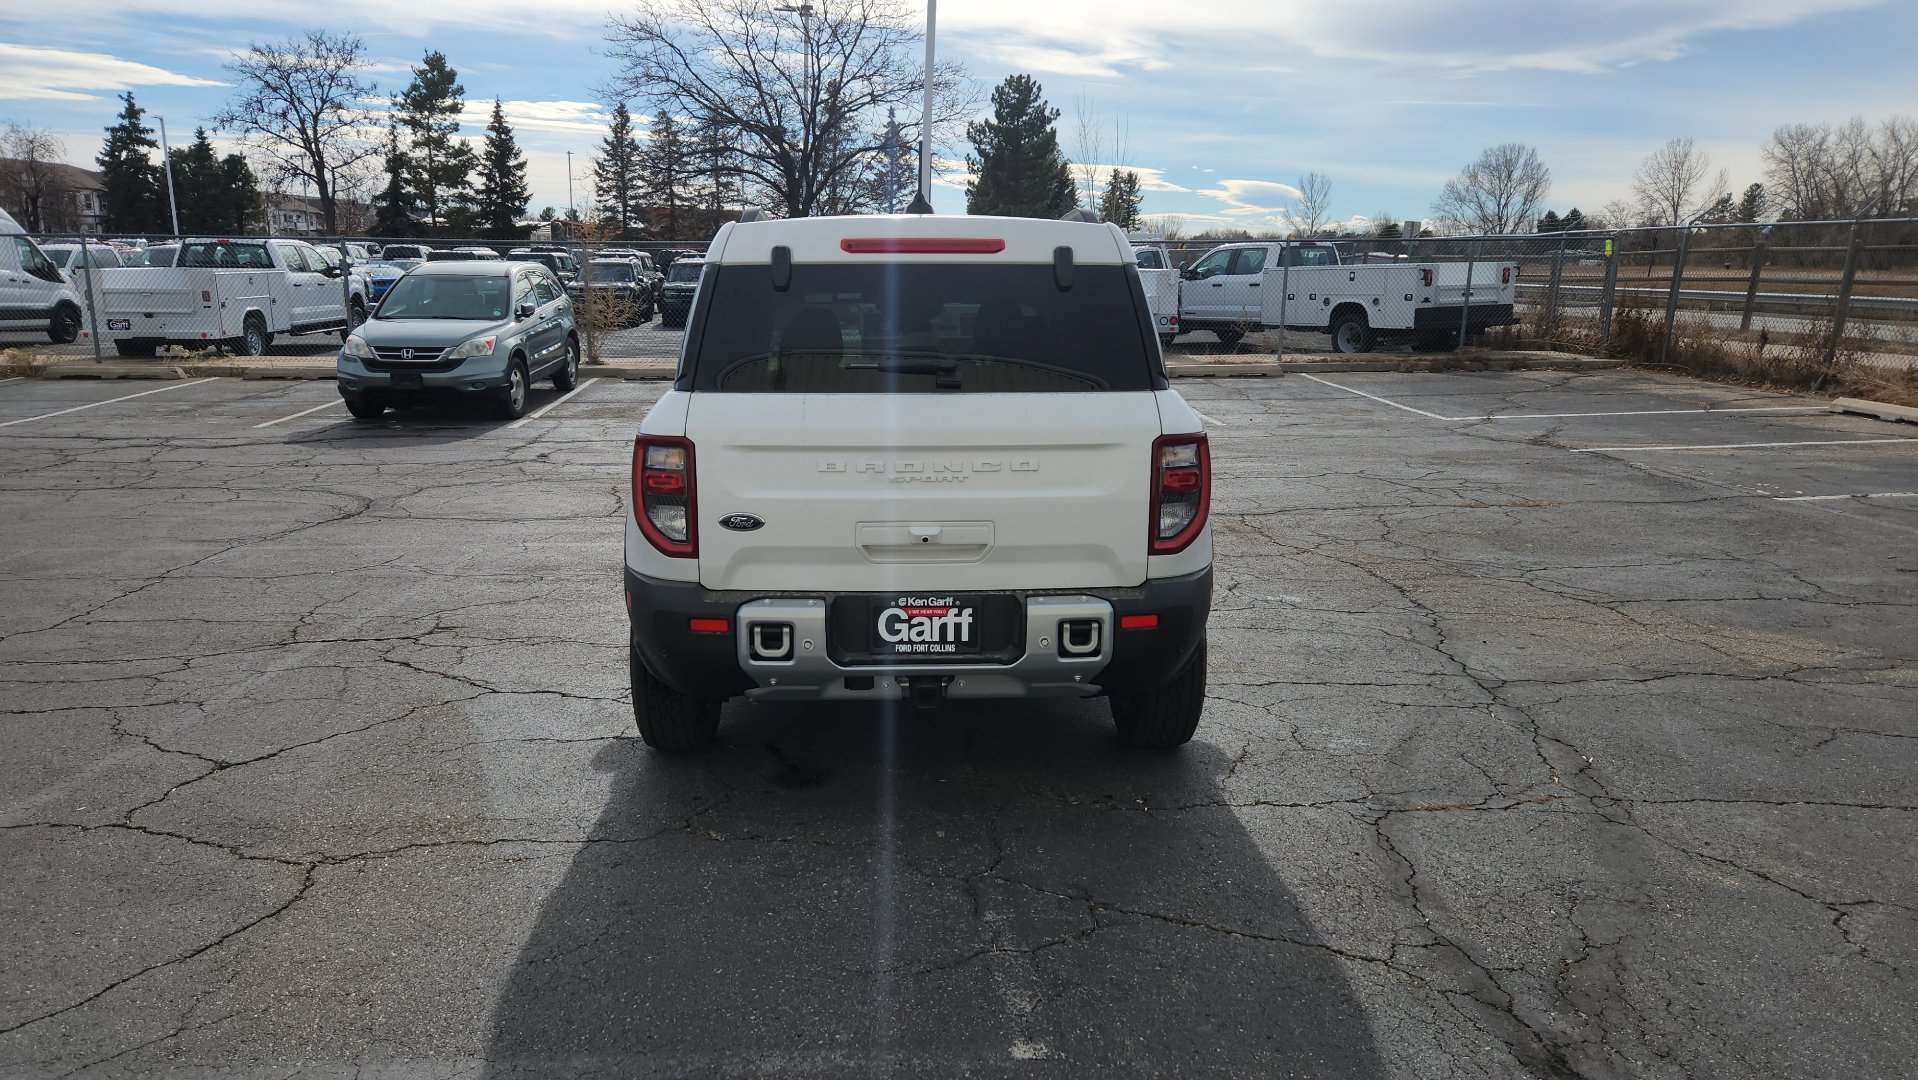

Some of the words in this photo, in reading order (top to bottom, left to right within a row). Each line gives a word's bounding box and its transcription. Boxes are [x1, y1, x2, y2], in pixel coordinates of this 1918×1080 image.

[816, 460, 1040, 473] BRONCO
[888, 475, 969, 483] SPORT
[729, 516, 754, 527] Ford
[907, 597, 927, 606] Ken
[928, 597, 954, 606] Garff
[878, 608, 973, 642] Garff
[895, 644, 912, 652] FORD
[913, 644, 929, 652] FORT
[929, 644, 956, 652] COLLINS
